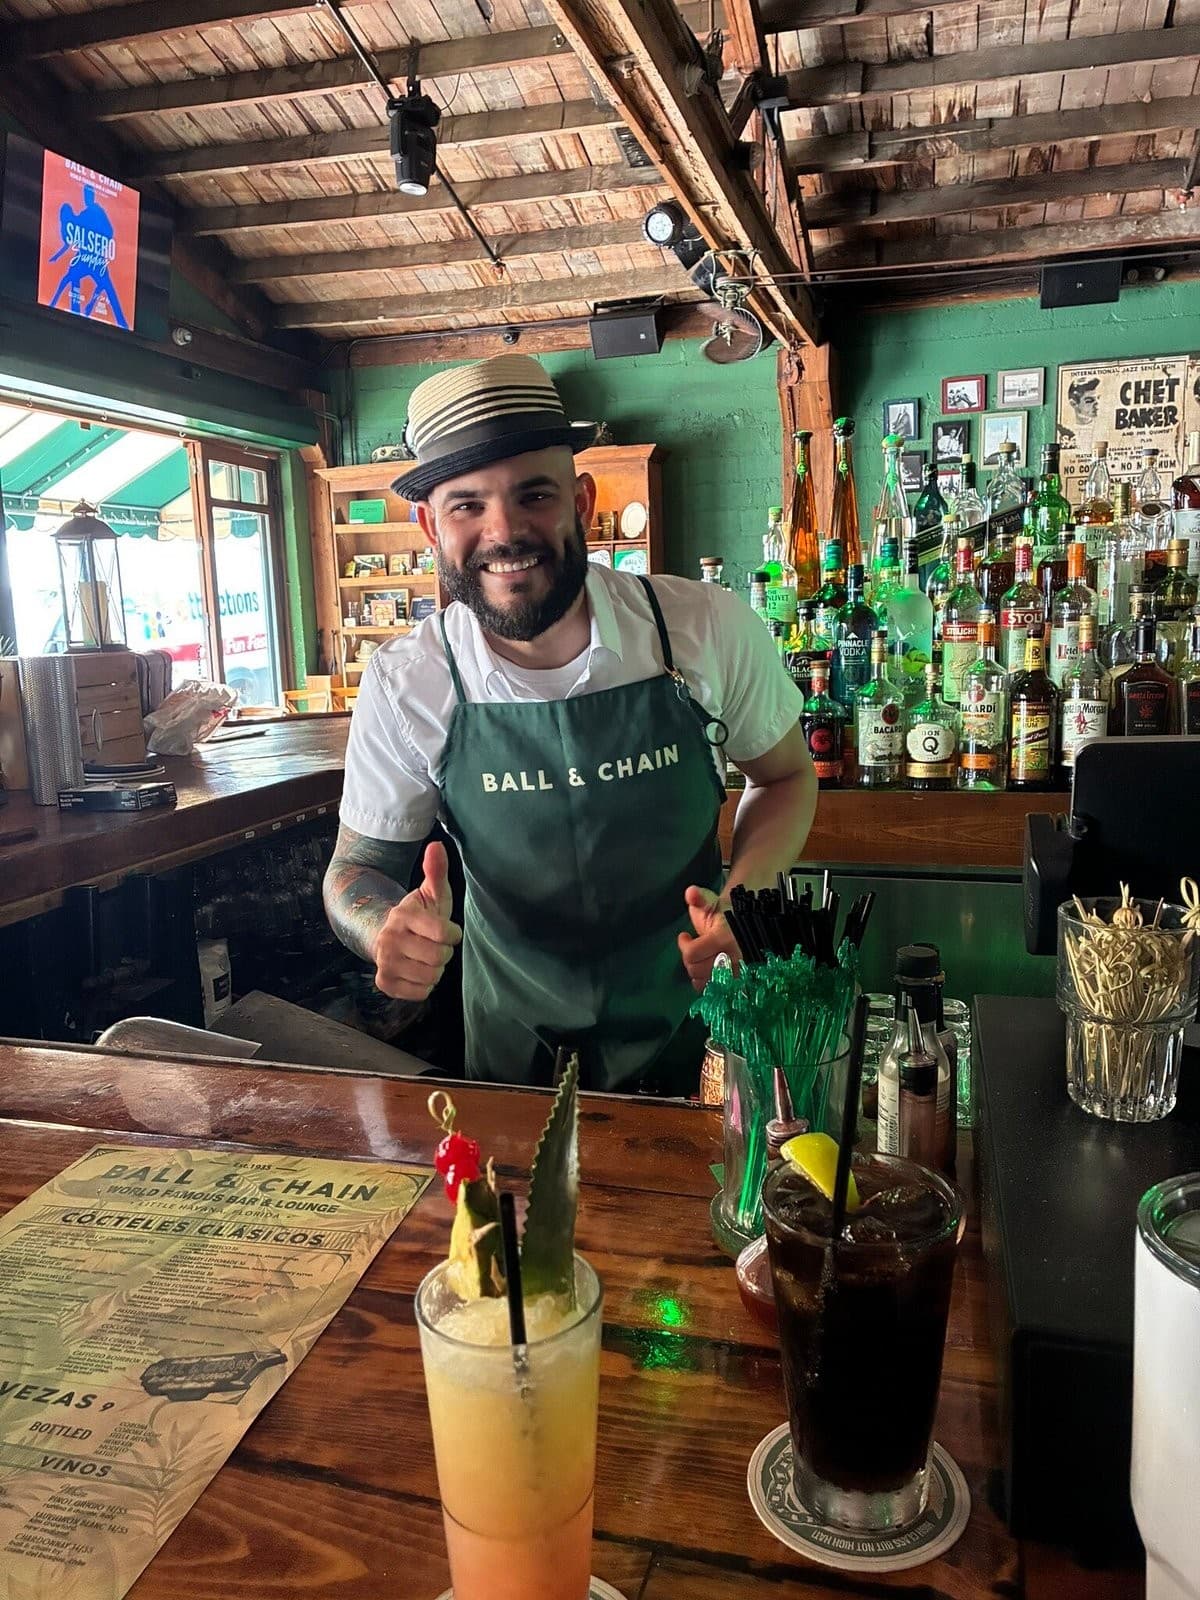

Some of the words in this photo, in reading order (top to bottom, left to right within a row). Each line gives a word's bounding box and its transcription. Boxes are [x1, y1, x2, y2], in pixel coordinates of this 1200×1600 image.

[65, 158, 87, 176] BALL
[98, 174, 122, 192] CHAIN
[66, 222, 116, 260] SALSERO
[69, 242, 111, 277] Sunday
[1071, 368, 1120, 376] INTERNATIONAL
[1122, 366, 1138, 374] JAZZ
[1141, 364, 1176, 372] SENSATION
[1120, 378, 1180, 406] CHET
[1115, 406, 1179, 430] BAKER
[1064, 466, 1075, 474] NO
[1121, 462, 1132, 471] NO
[768, 602, 776, 610] 12
[838, 640, 869, 648] PINNACLE
[839, 646, 867, 656] VODKA
[874, 726, 902, 734] BACARD
[922, 736, 939, 755] Q
[482, 770, 554, 792] BALL
[568, 767, 586, 788] &
[598, 744, 680, 782] CHAIN
[101, 1165, 195, 1185] BALL
[215, 1173, 240, 1188] &
[258, 1178, 379, 1202] CHAIN
[106, 1185, 158, 1198] WORLD
[161, 1189, 224, 1203] FAMOUS
[226, 1195, 258, 1206] BAR
[258, 1198, 273, 1208] &
[275, 1200, 340, 1214] LOUNGE
[138, 1200, 176, 1210] LITTLE
[231, 1208, 280, 1219] FLORIDA
[61, 1210, 190, 1234] CÓCTELES
[197, 1222, 326, 1246] CLÁSICOS
[0, 1381, 98, 1409] VEZAS
[29, 1421, 92, 1440] BOTTLED
[40, 1456, 112, 1478] VINOS
[832, 1538, 854, 1550] HIGH
[856, 1542, 875, 1552] NOT
[876, 1540, 895, 1552] BUT
